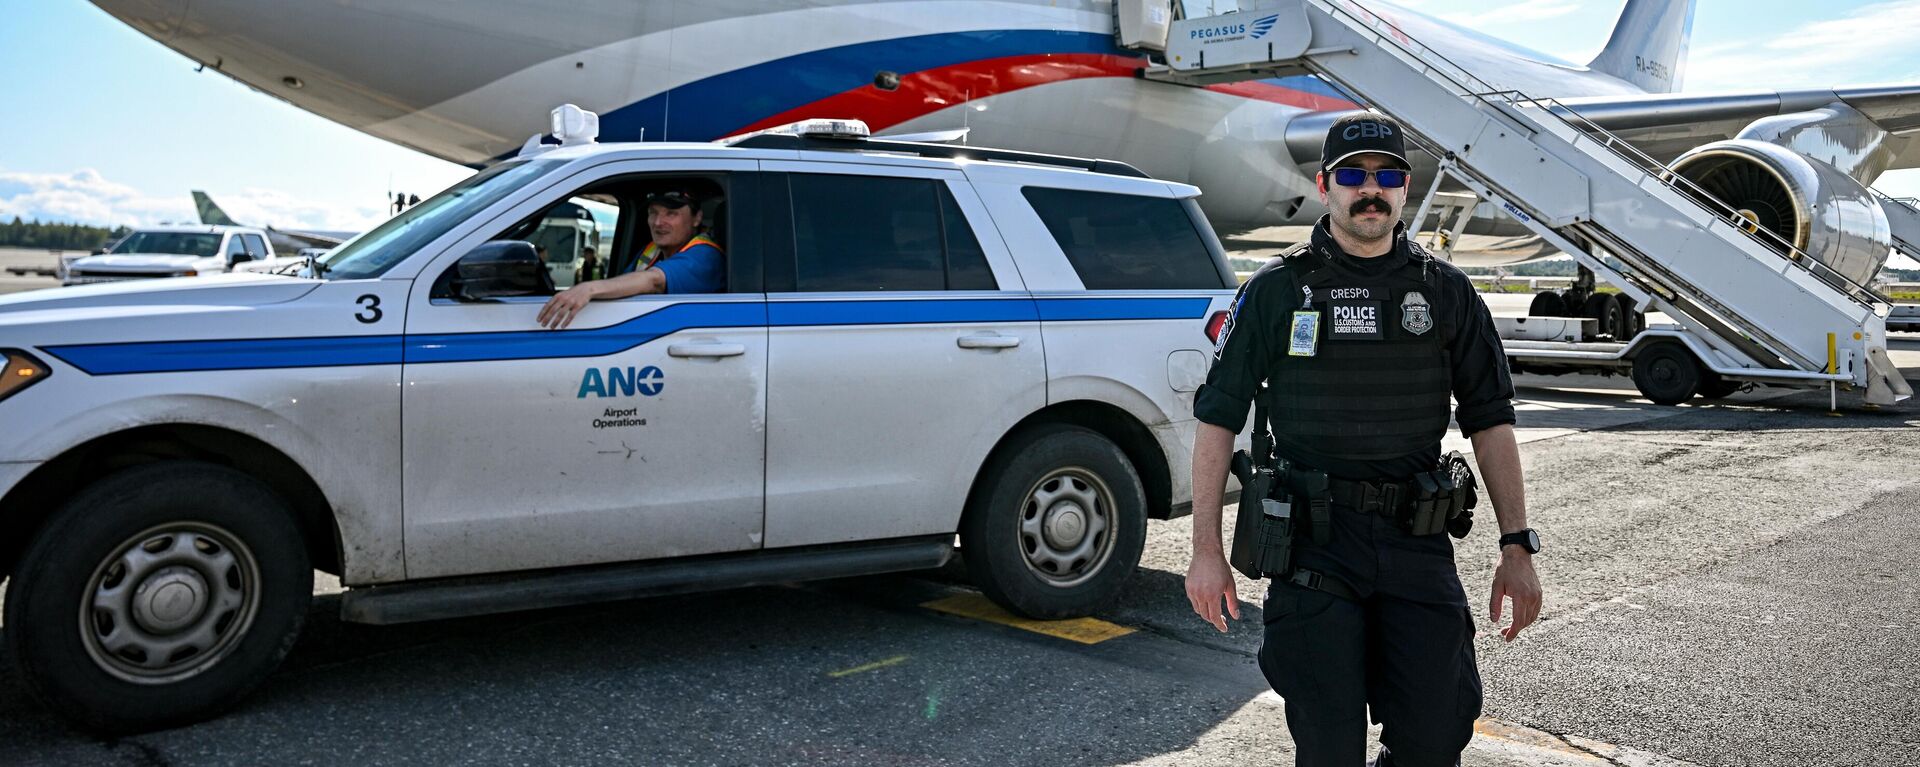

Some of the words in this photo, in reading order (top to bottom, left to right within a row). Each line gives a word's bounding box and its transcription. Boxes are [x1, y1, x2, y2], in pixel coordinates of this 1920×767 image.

[1190, 24, 1246, 39] PEGASUS
[1342, 122, 1393, 141] CBP
[1503, 202, 1530, 222] WOLLARD
[1330, 287, 1370, 300] CRESPO
[354, 293, 383, 324] 3
[1333, 305, 1376, 320] POLICE
[1334, 326, 1351, 334] BORDER
[1351, 326, 1377, 334] PROTECTION
[603, 407, 637, 418] Airport
[592, 418, 647, 429] Operations
